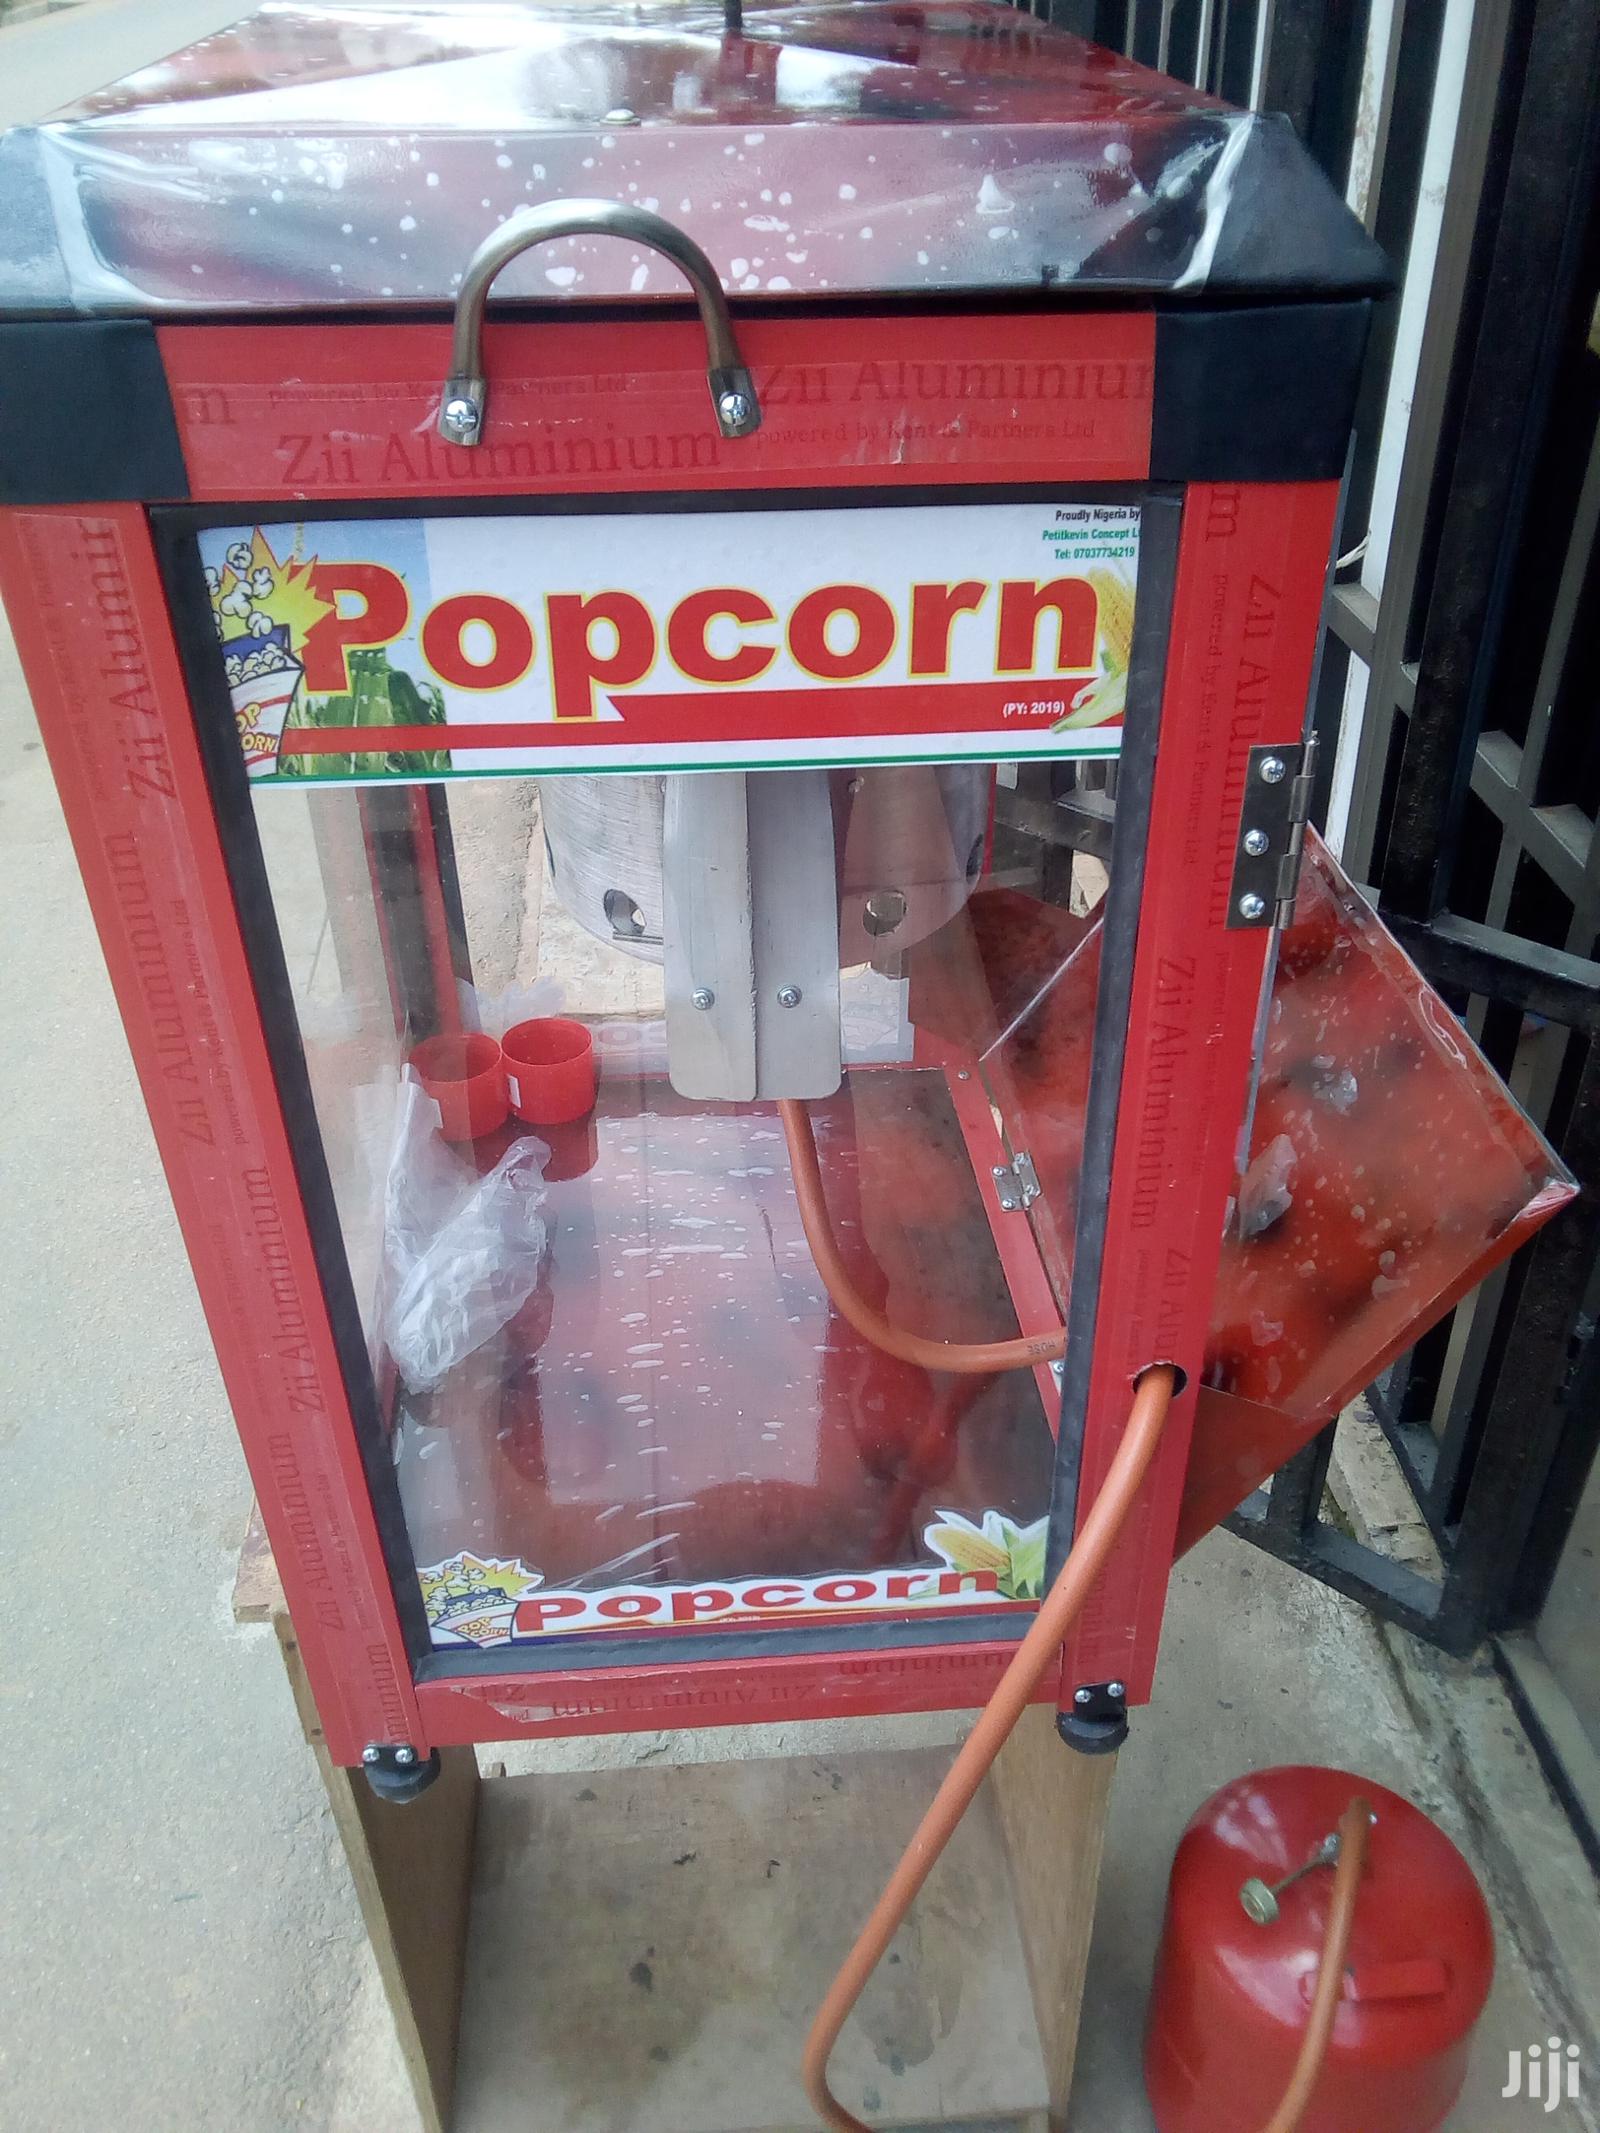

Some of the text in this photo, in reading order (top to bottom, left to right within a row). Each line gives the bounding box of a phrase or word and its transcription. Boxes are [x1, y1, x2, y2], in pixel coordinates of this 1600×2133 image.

[1055, 507, 1141, 523] Proudly Nigeria by
[1091, 527, 1130, 540] Concept
[1054, 548, 1072, 560] Tel:
[298, 560, 1102, 722] Popcorn
[1030, 700, 1066, 716] 2019)
[241, 732, 278, 752] ORN
[514, 1567, 999, 1634] Popcorn
